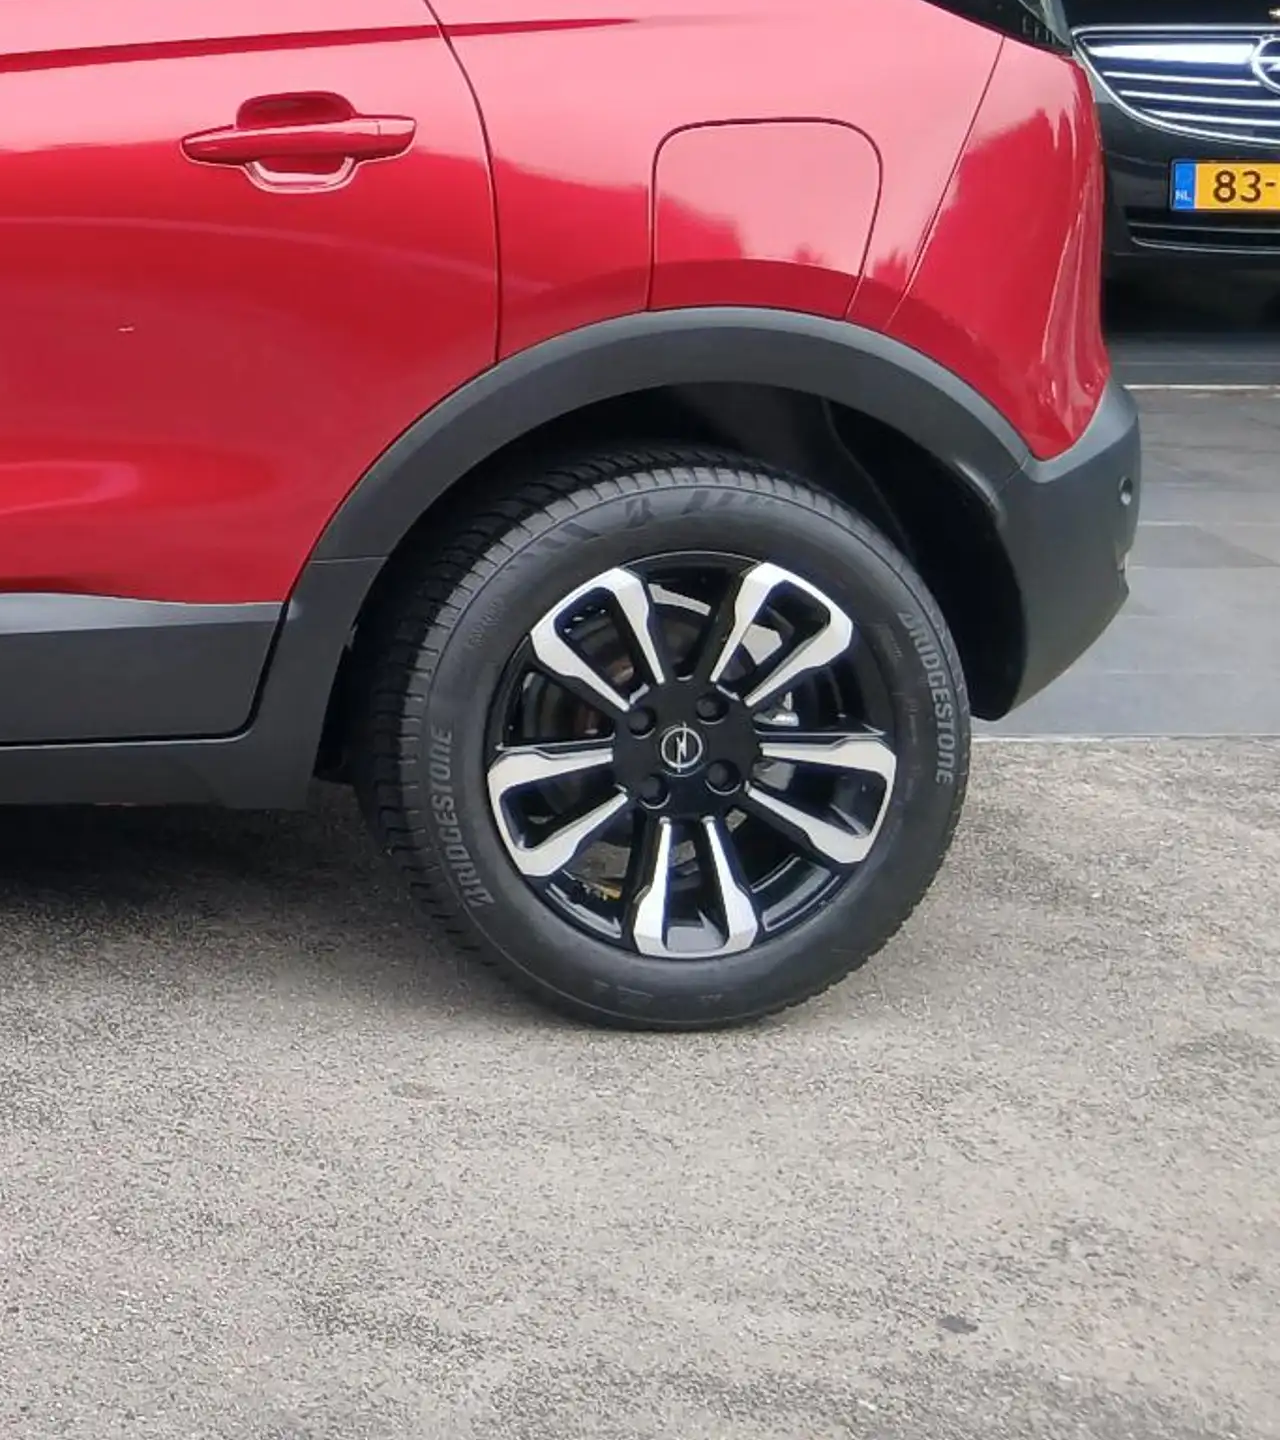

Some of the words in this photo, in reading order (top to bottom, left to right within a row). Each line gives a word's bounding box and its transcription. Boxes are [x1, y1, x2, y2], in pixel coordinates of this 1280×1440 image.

[1175, 188, 1192, 202] NL
[899, 611, 957, 786] BRIDGESTONE
[427, 727, 493, 908] BRIDGESTONE
